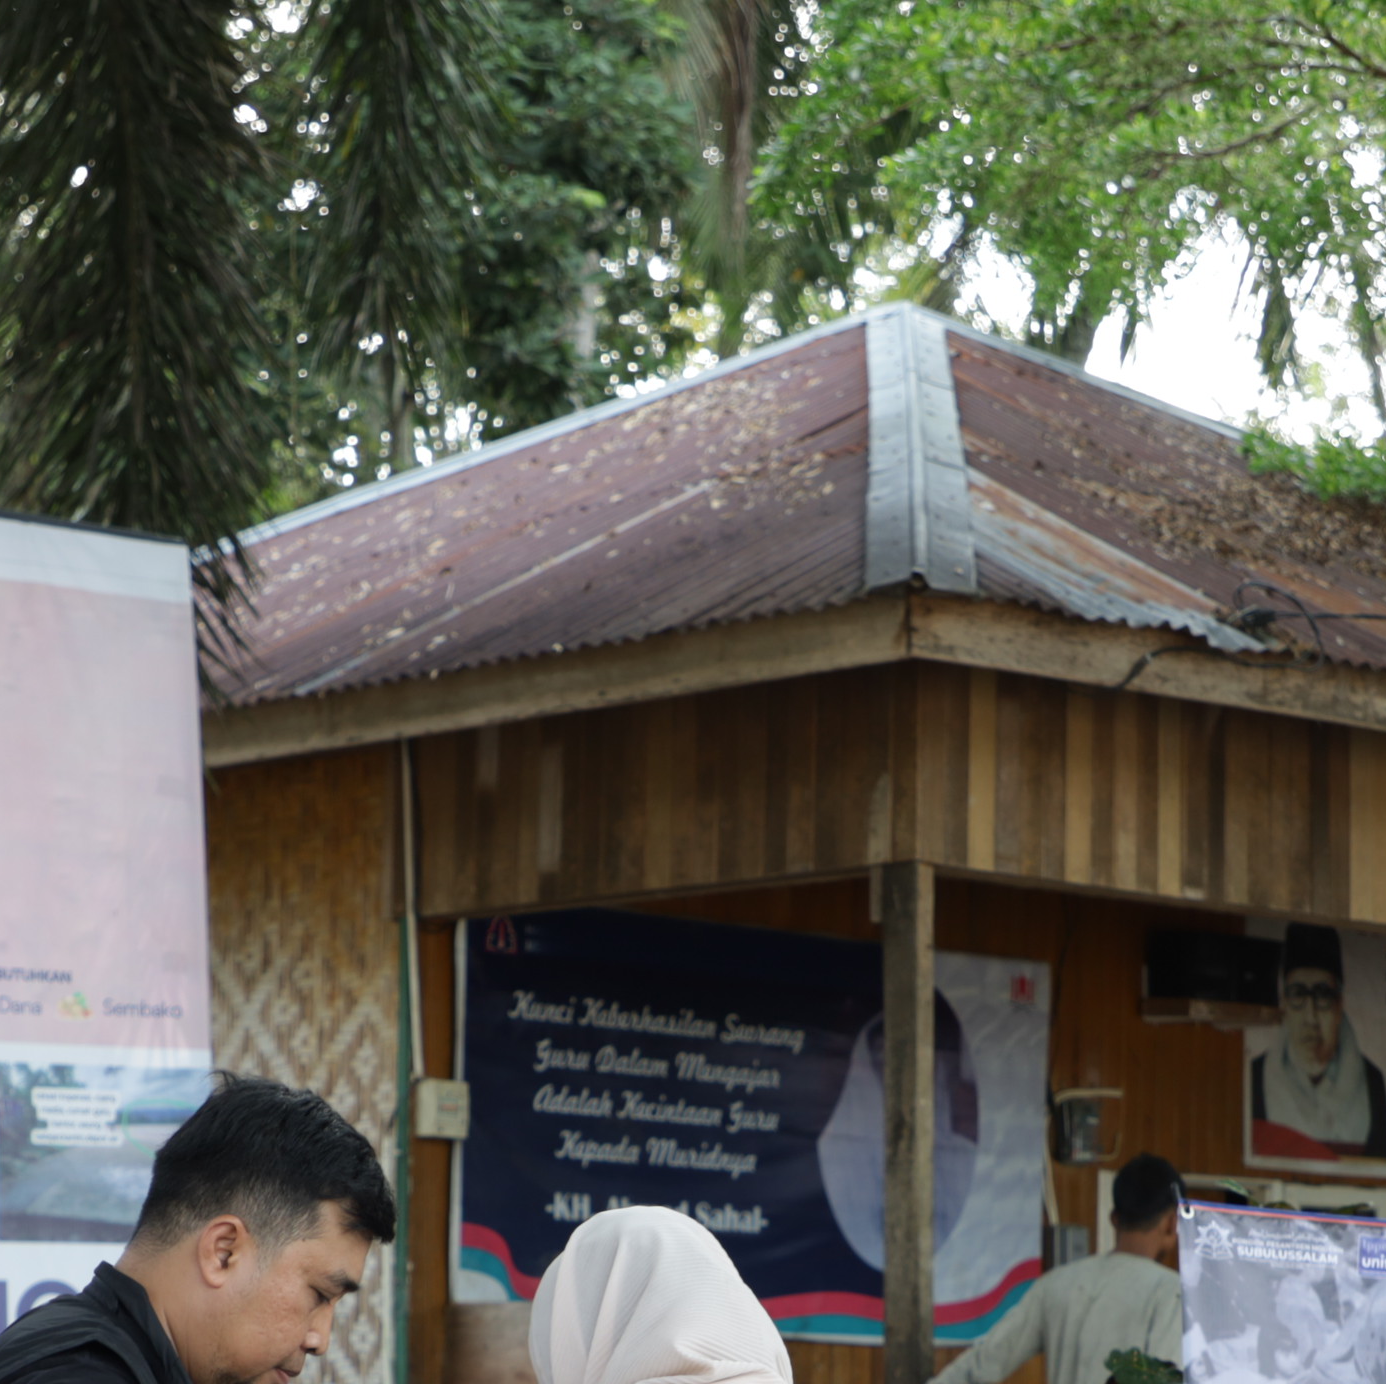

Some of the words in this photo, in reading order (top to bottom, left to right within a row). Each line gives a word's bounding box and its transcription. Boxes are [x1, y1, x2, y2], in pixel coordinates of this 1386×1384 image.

[102, 998, 183, 1019] Sembako
[507, 990, 576, 1024] Kunci
[578, 997, 716, 1039] Keberhasilan
[720, 1013, 806, 1055] Seorang
[533, 1038, 590, 1073] Guru
[594, 1045, 669, 1079] Dalam
[675, 1051, 781, 1093] Mengajar
[532, 1084, 612, 1119] Adalah
[616, 1090, 722, 1128] Kecintaan
[725, 1101, 780, 1134] Guru
[554, 1130, 640, 1168] Kepada
[645, 1137, 757, 1179] Muridnya
[1237, 1245, 1339, 1264] SUBULUSSALAM
